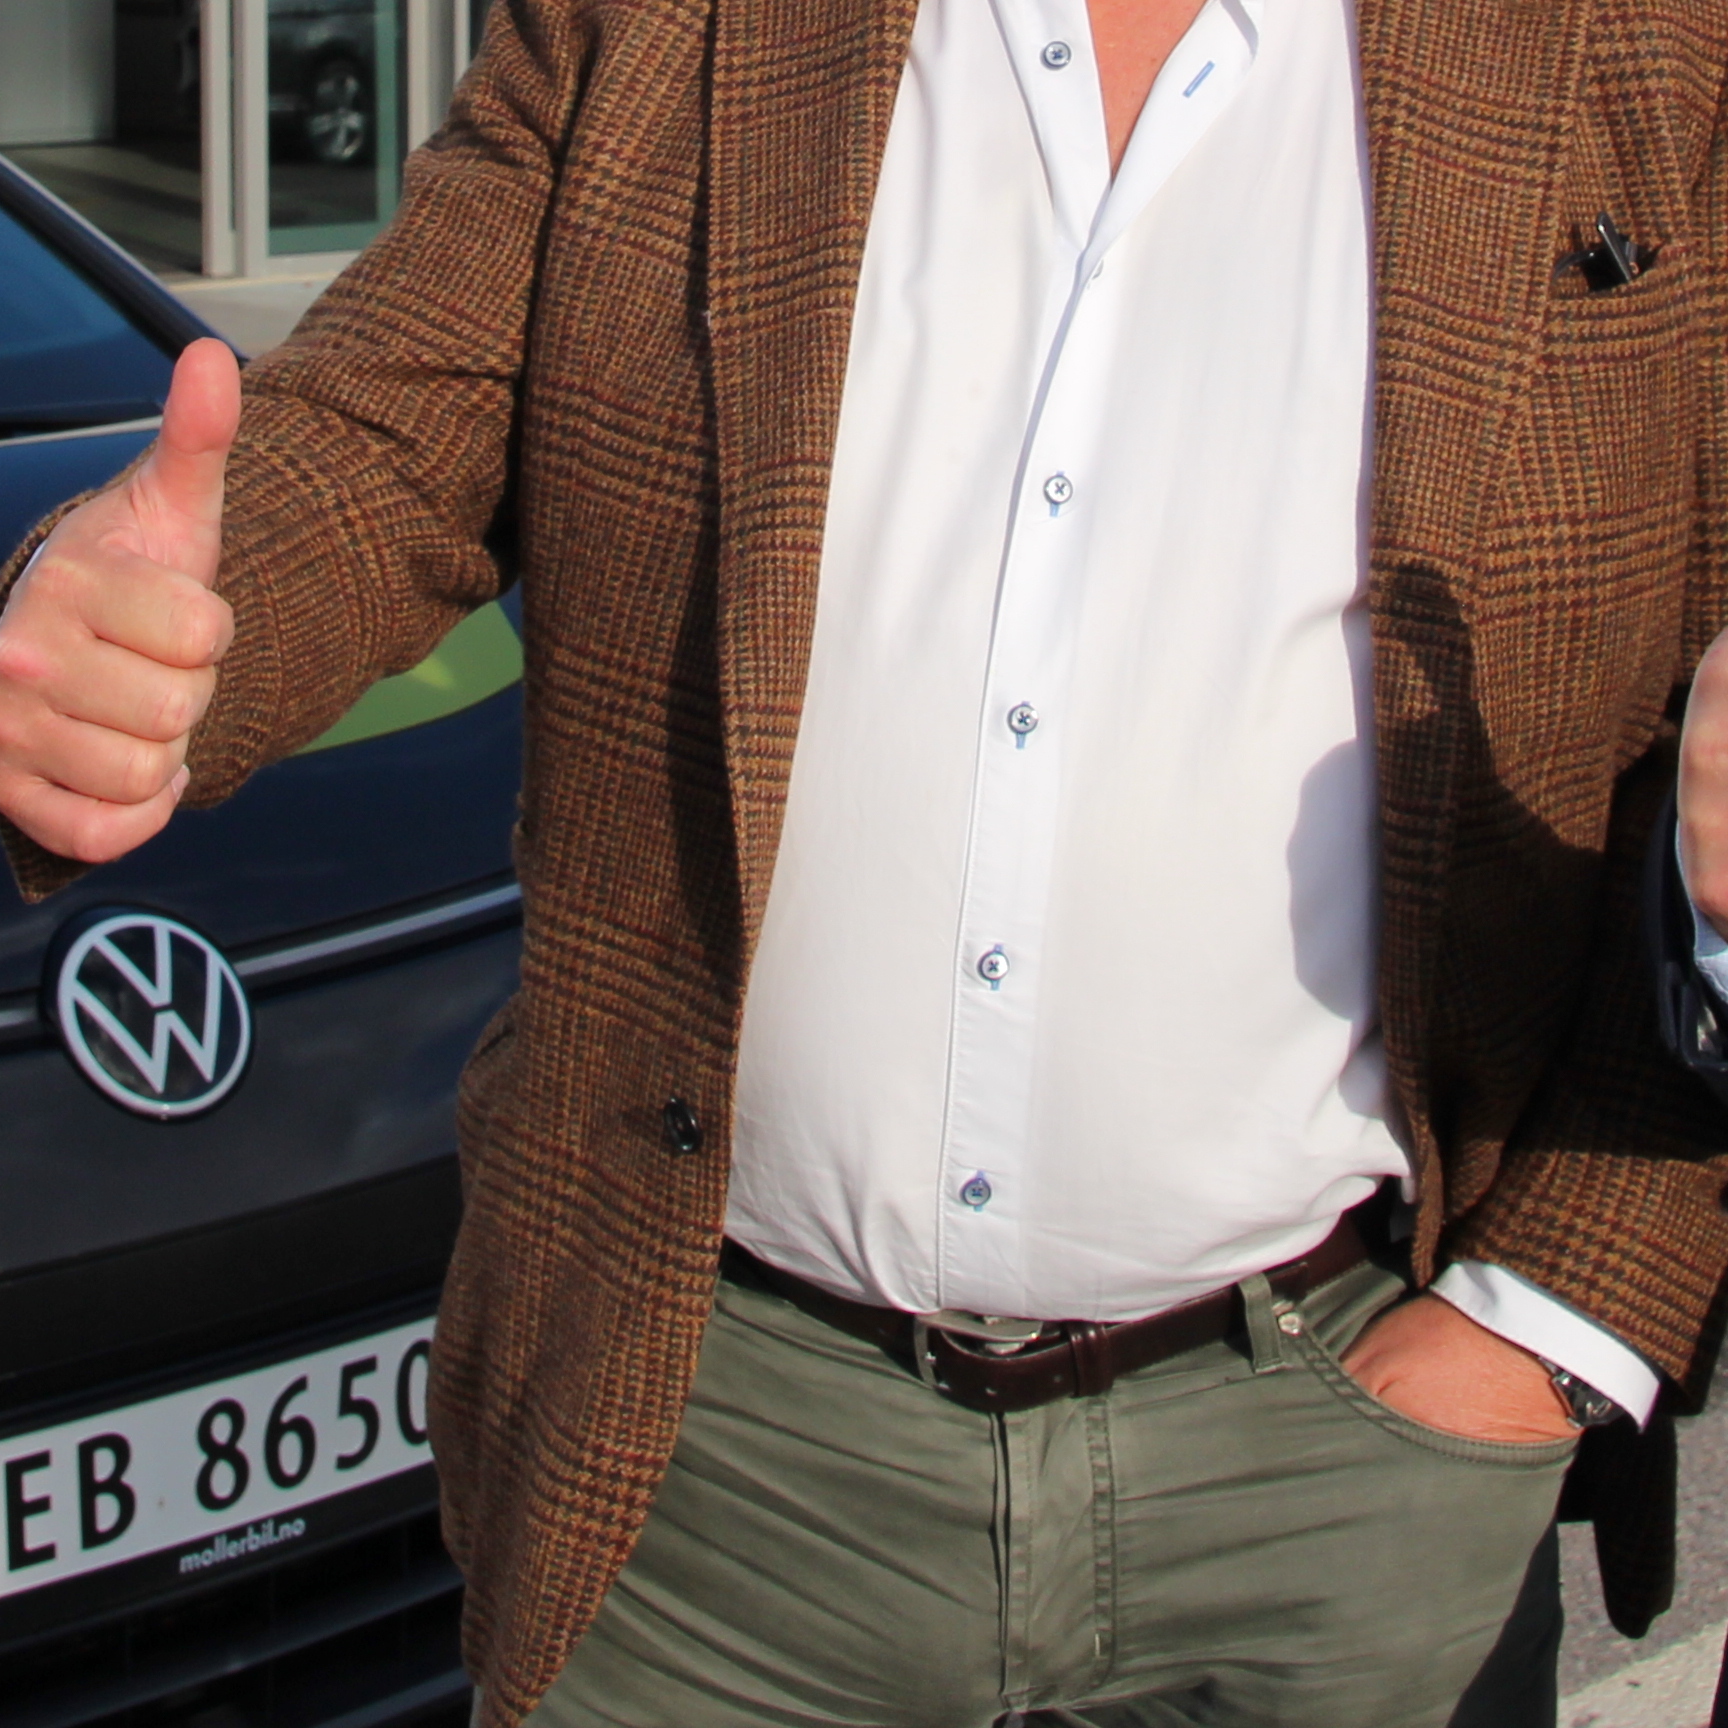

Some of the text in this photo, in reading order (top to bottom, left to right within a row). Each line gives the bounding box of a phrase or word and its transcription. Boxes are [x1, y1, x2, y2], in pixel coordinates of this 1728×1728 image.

[58, 913, 251, 1117] VW
[3, 1338, 432, 1573] EB 8650
